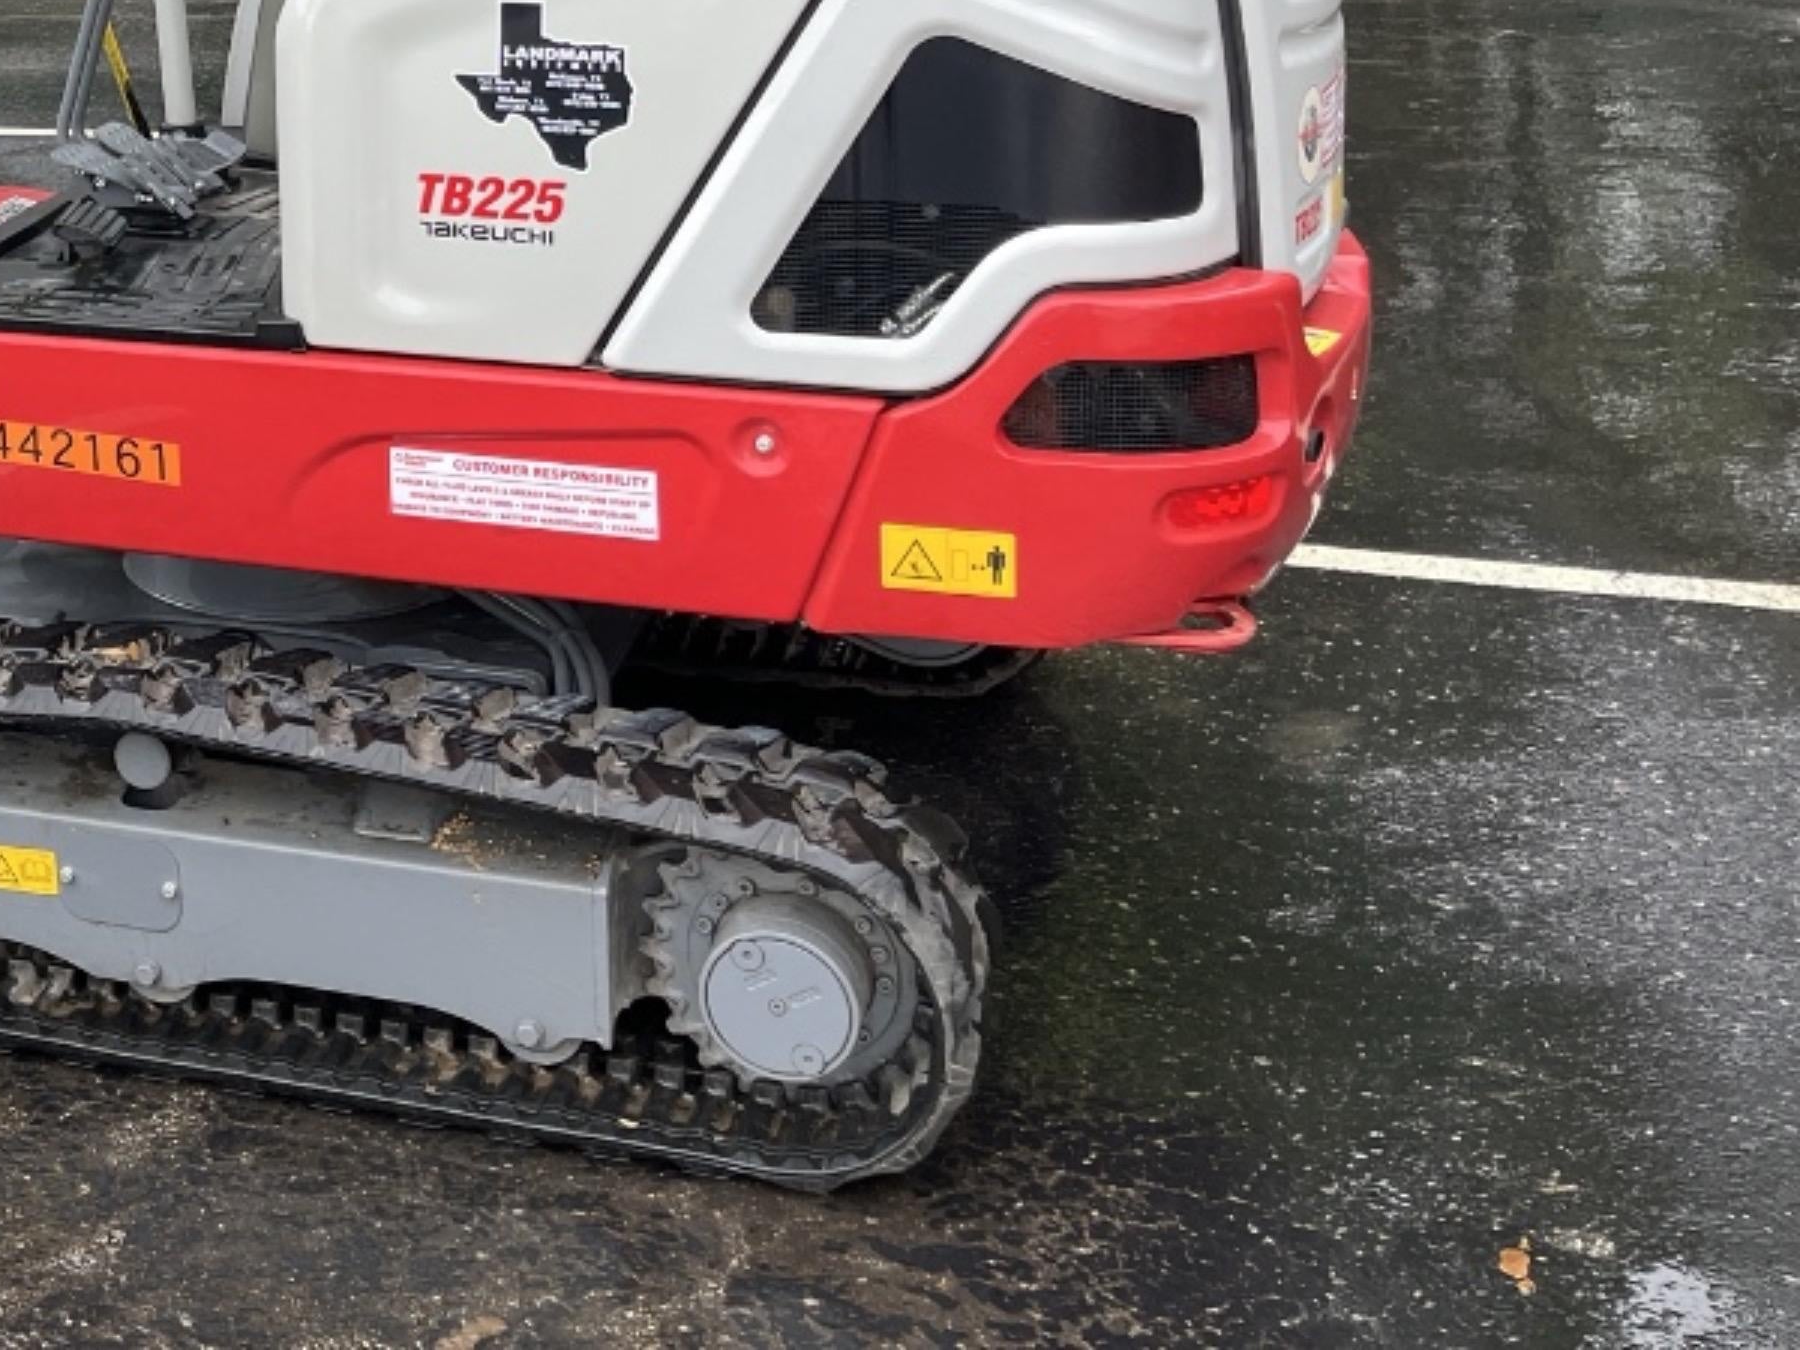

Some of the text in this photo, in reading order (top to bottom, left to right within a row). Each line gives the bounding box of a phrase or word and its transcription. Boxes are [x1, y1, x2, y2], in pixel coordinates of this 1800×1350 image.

[418, 173, 567, 224] TB225
[452, 458, 530, 476] CUSTOMER
[532, 466, 650, 489] RESPONSIBILITY
